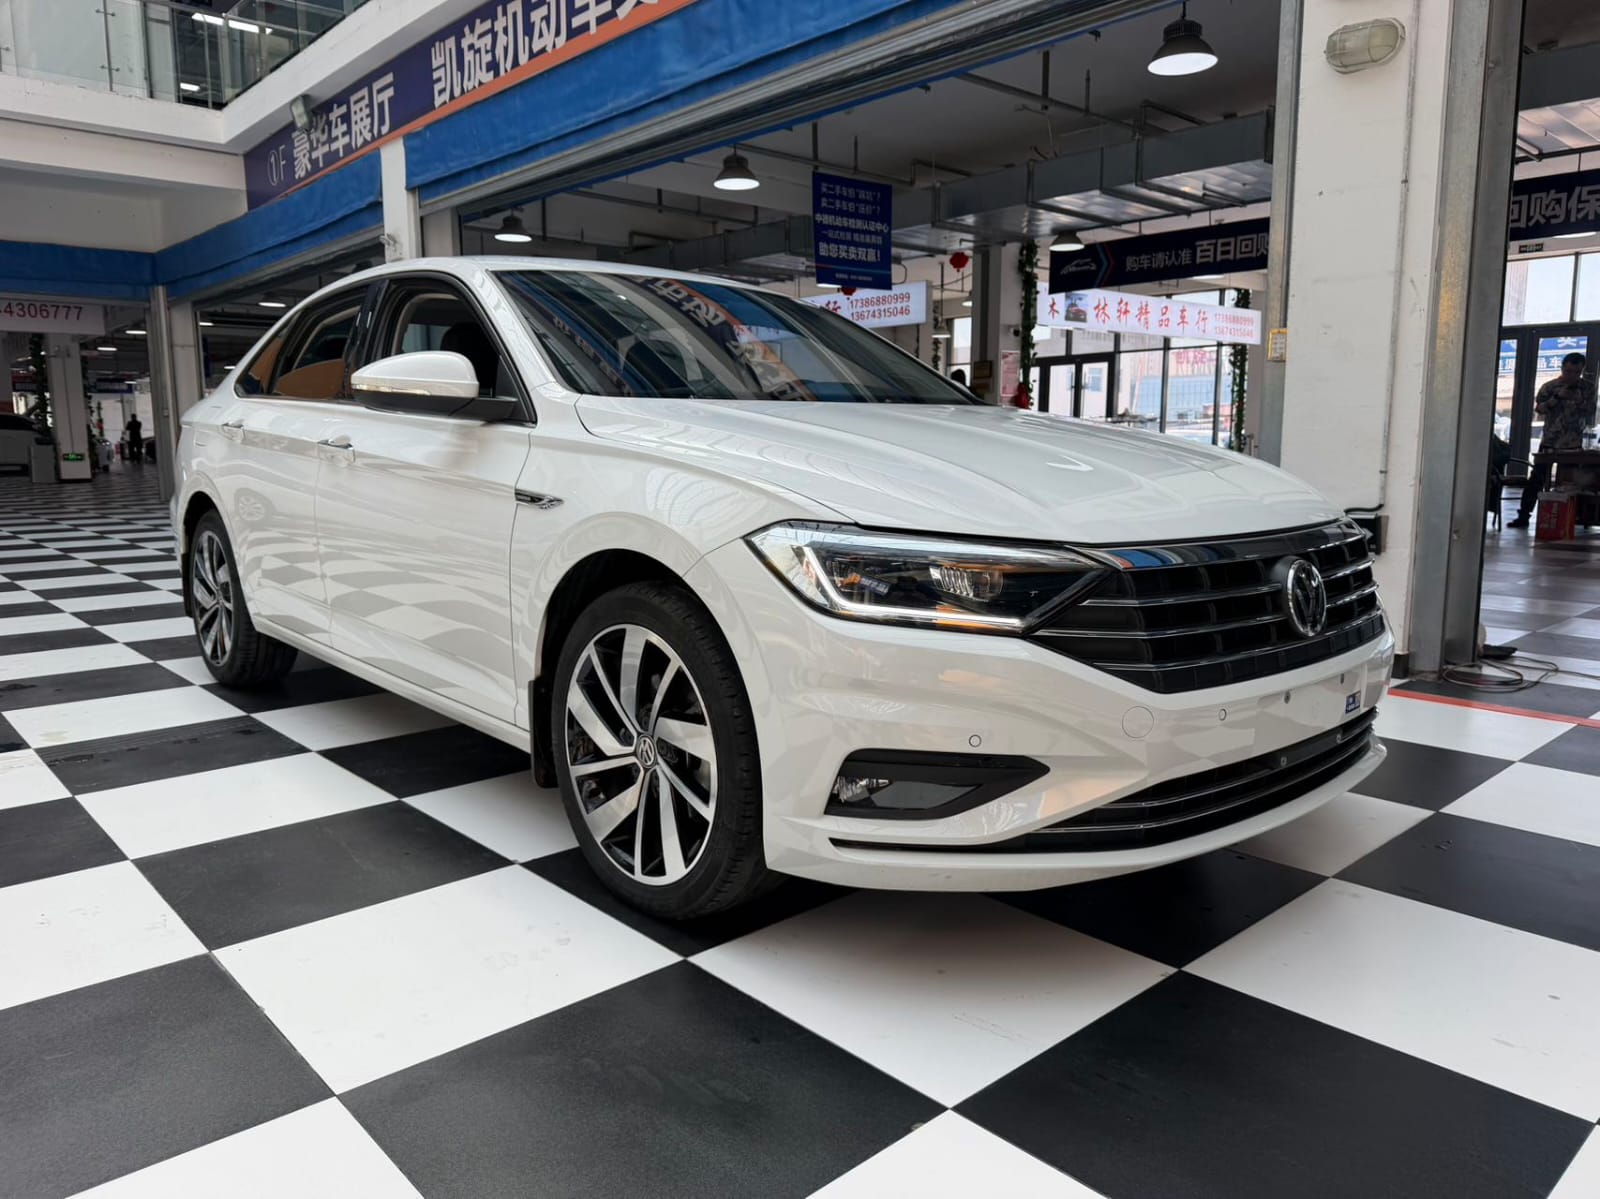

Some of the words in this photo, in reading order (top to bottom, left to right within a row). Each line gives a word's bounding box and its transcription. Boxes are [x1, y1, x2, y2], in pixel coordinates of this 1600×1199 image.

[292, 72, 395, 181] 豪华车展厅
[431, 0, 660, 109] 凯旋机动车
[1125, 248, 1193, 272] 购车请认准
[849, 292, 911, 309] 17386880999
[0, 302, 83, 321] 4306777
[851, 305, 911, 321] 13674315046
